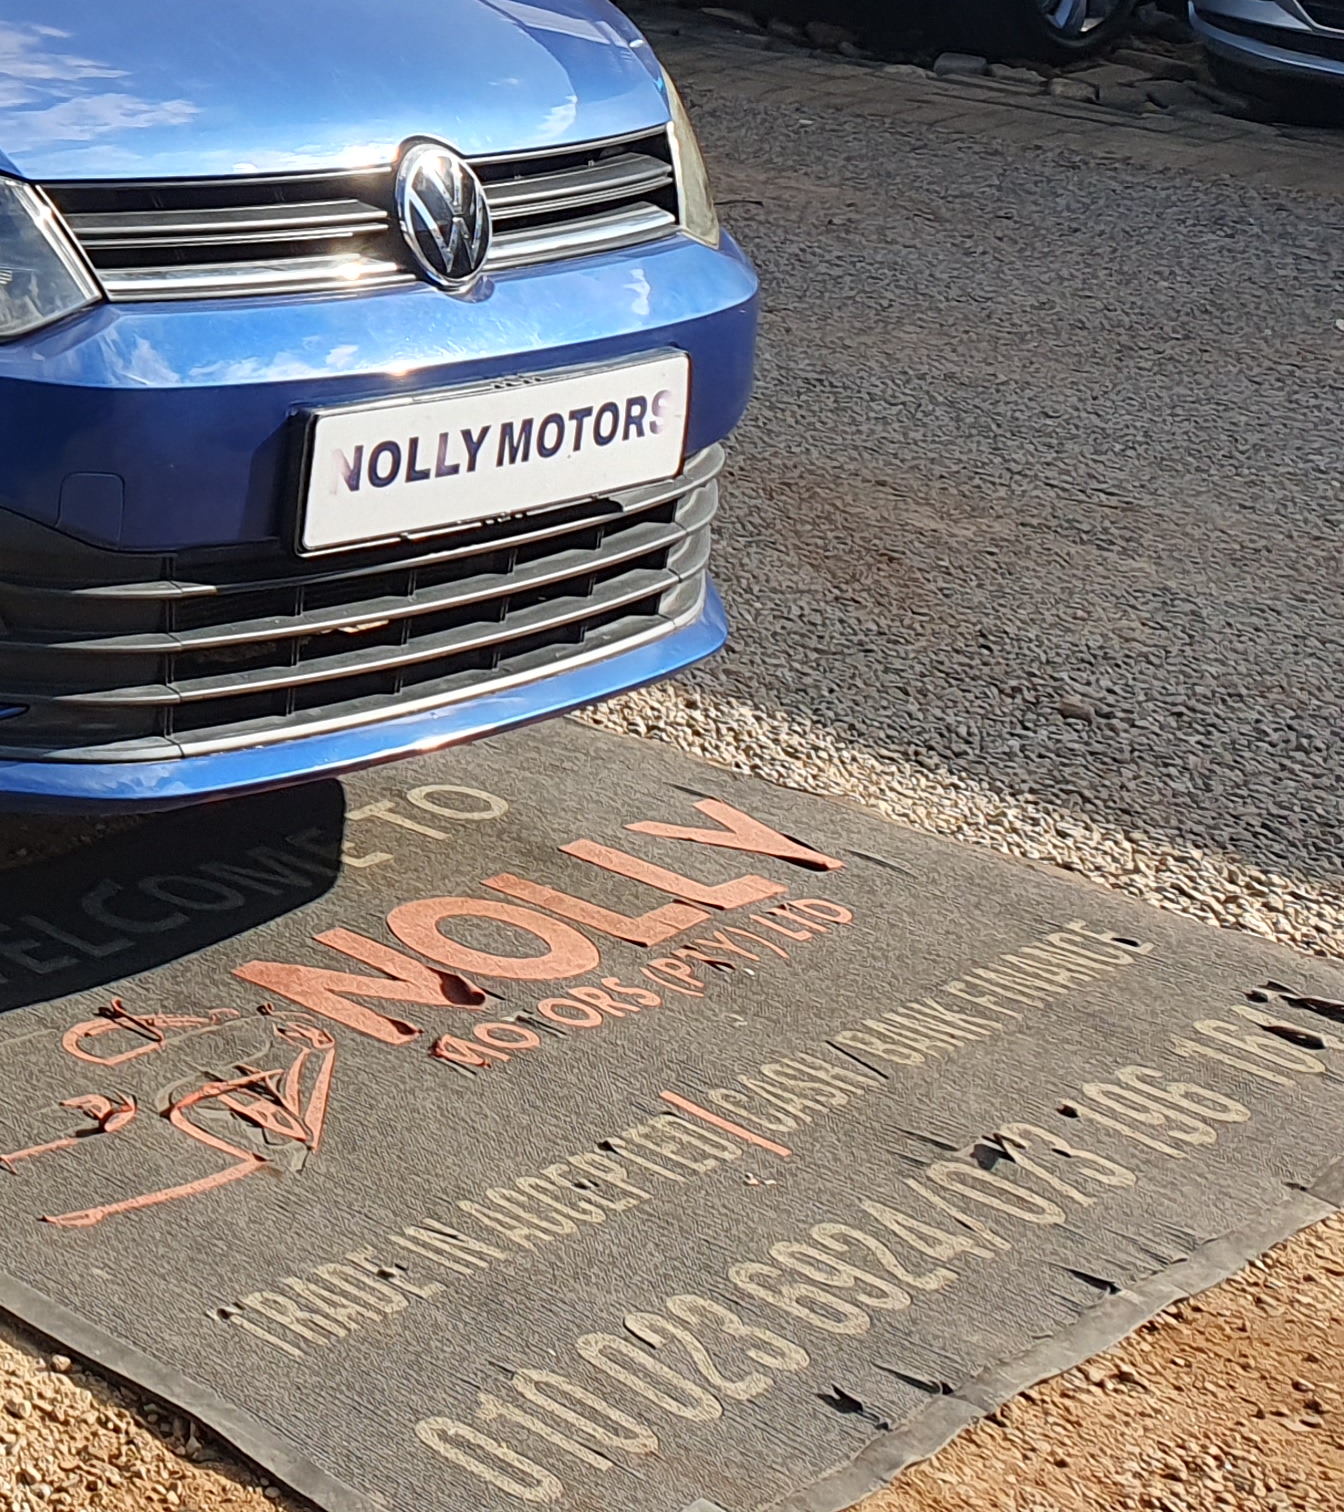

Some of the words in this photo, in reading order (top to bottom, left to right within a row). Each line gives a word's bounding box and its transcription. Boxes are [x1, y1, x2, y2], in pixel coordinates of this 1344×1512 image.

[330, 424, 492, 494] NOLLY
[495, 389, 674, 468] MOTORS
[346, 784, 510, 841] TO
[229, 797, 846, 1045] NOLLY
[748, 897, 854, 942] LTD
[205, 1244, 448, 1360] TRADE
[388, 1218, 508, 1276] IN
[457, 1111, 744, 1257] ACCEPTED
[709, 1050, 882, 1133] CASH
[835, 996, 1003, 1065] BANK
[942, 919, 1155, 1020] FINANCE
[414, 1368, 660, 1504] 010
[575, 1294, 811, 1422] 023
[1057, 1064, 1252, 1160] 196
